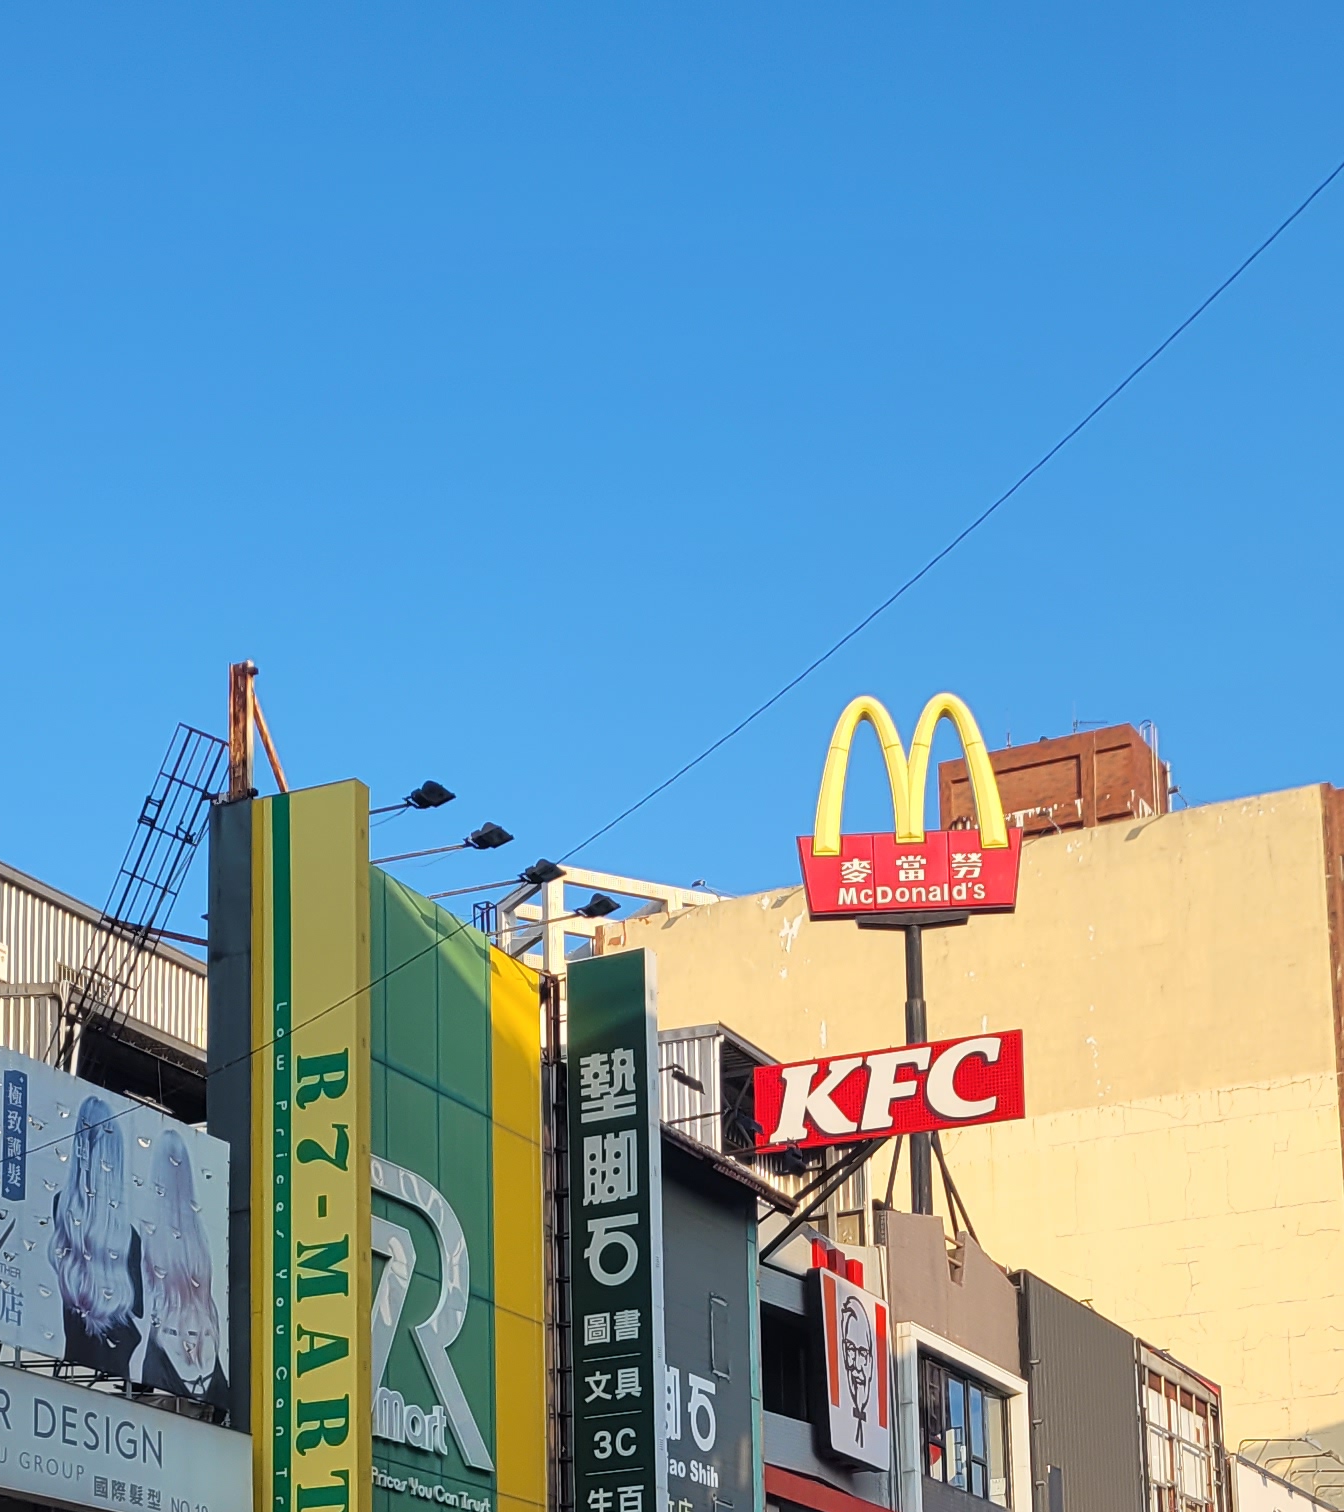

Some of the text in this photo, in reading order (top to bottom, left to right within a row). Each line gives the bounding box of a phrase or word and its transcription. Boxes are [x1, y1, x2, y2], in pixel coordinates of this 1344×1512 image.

[840, 852, 983, 884] 麥當勞
[837, 882, 986, 906] McDonald's
[768, 1036, 1002, 1145] KFC
[6, 1082, 23, 1188] 極致護髮
[579, 1046, 640, 1287] 墊腳石
[582, 1307, 643, 1346] 圖書
[583, 1366, 644, 1404] 文具
[33, 1399, 166, 1470] DESIGN
[592, 1426, 639, 1459] 3C
[20, 1450, 86, 1482] GROUP
[665, 1453, 719, 1489] ao Shih
[93, 1474, 163, 1512] 國際髮型
[408, 1476, 433, 1500] You
[433, 1485, 459, 1507] Can
